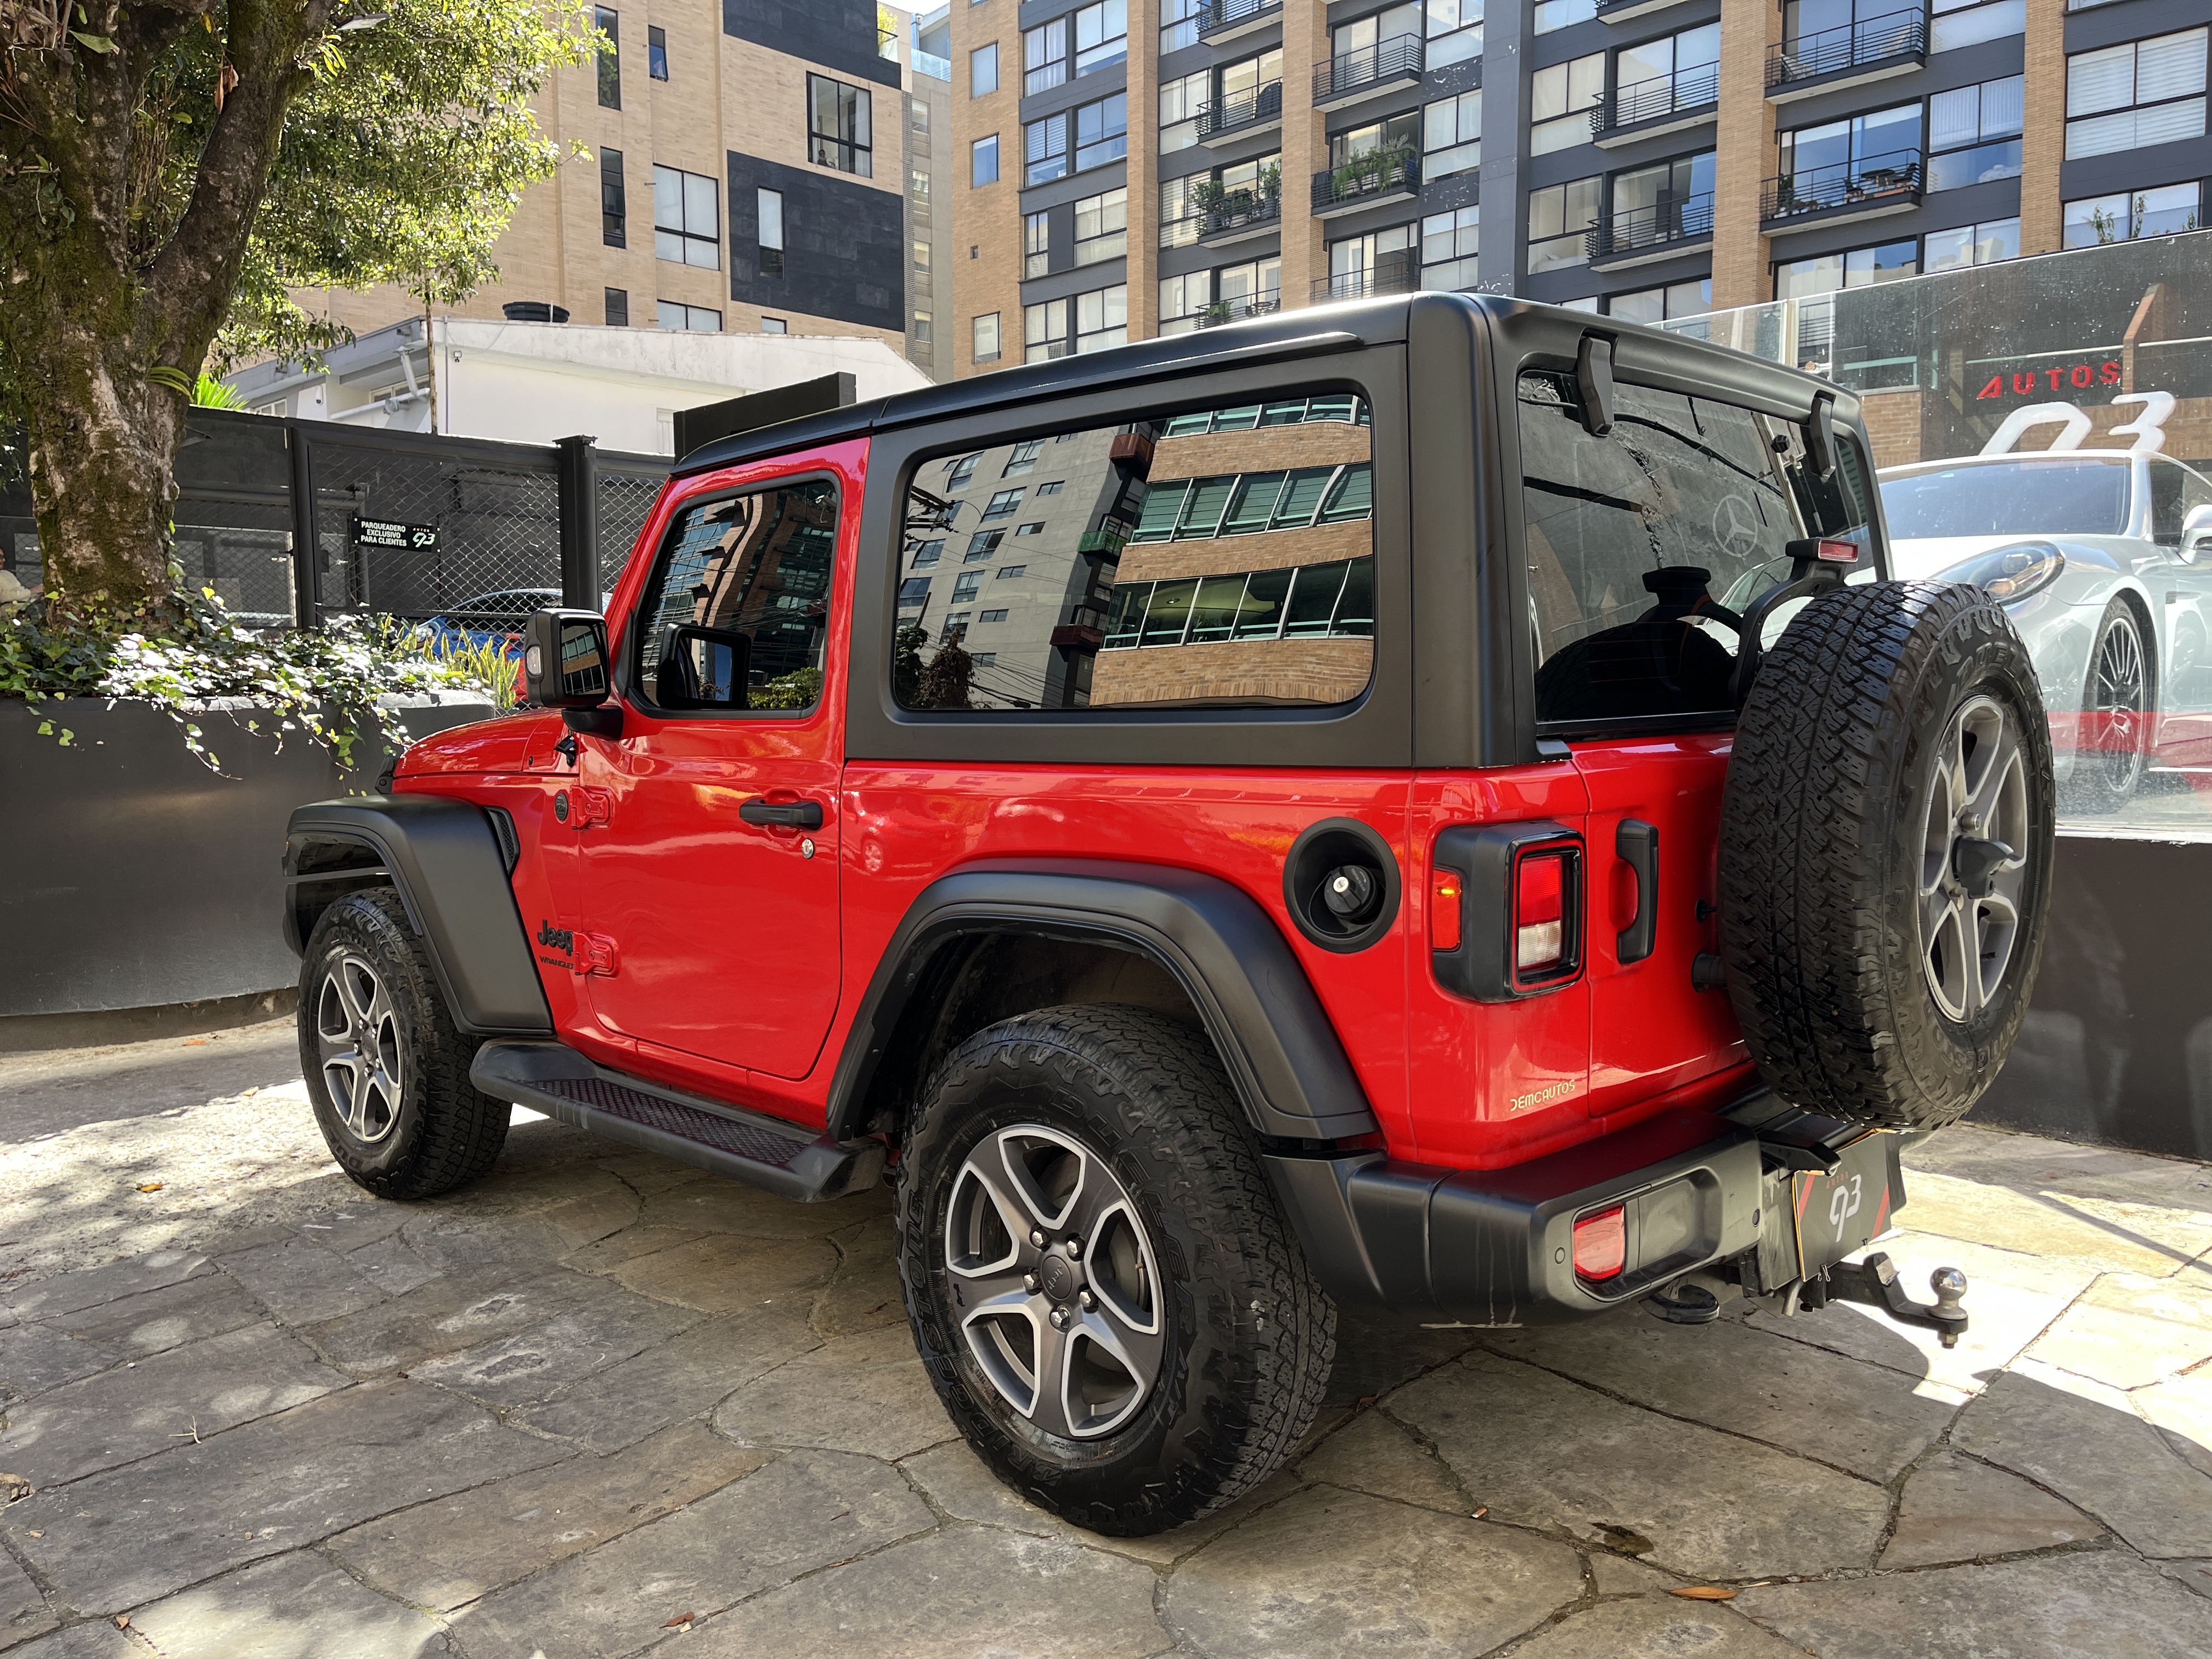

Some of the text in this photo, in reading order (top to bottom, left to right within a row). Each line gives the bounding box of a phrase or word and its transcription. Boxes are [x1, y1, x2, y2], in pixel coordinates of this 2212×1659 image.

[1976, 362, 2121, 400] AUTOS
[361, 521, 406, 533] PARQUEADERO
[366, 529, 401, 539] EXCLUSIVO
[413, 532, 436, 548] 93
[360, 535, 407, 547] PARA CLIENTES
[537, 919, 573, 956] Jeep
[1826, 1171, 1849, 1189] AUTOS
[1049, 1087, 1197, 1335] DUELER
[1830, 1173, 1861, 1243] 93
[906, 1189, 1065, 1488] BRIDGESTONE
